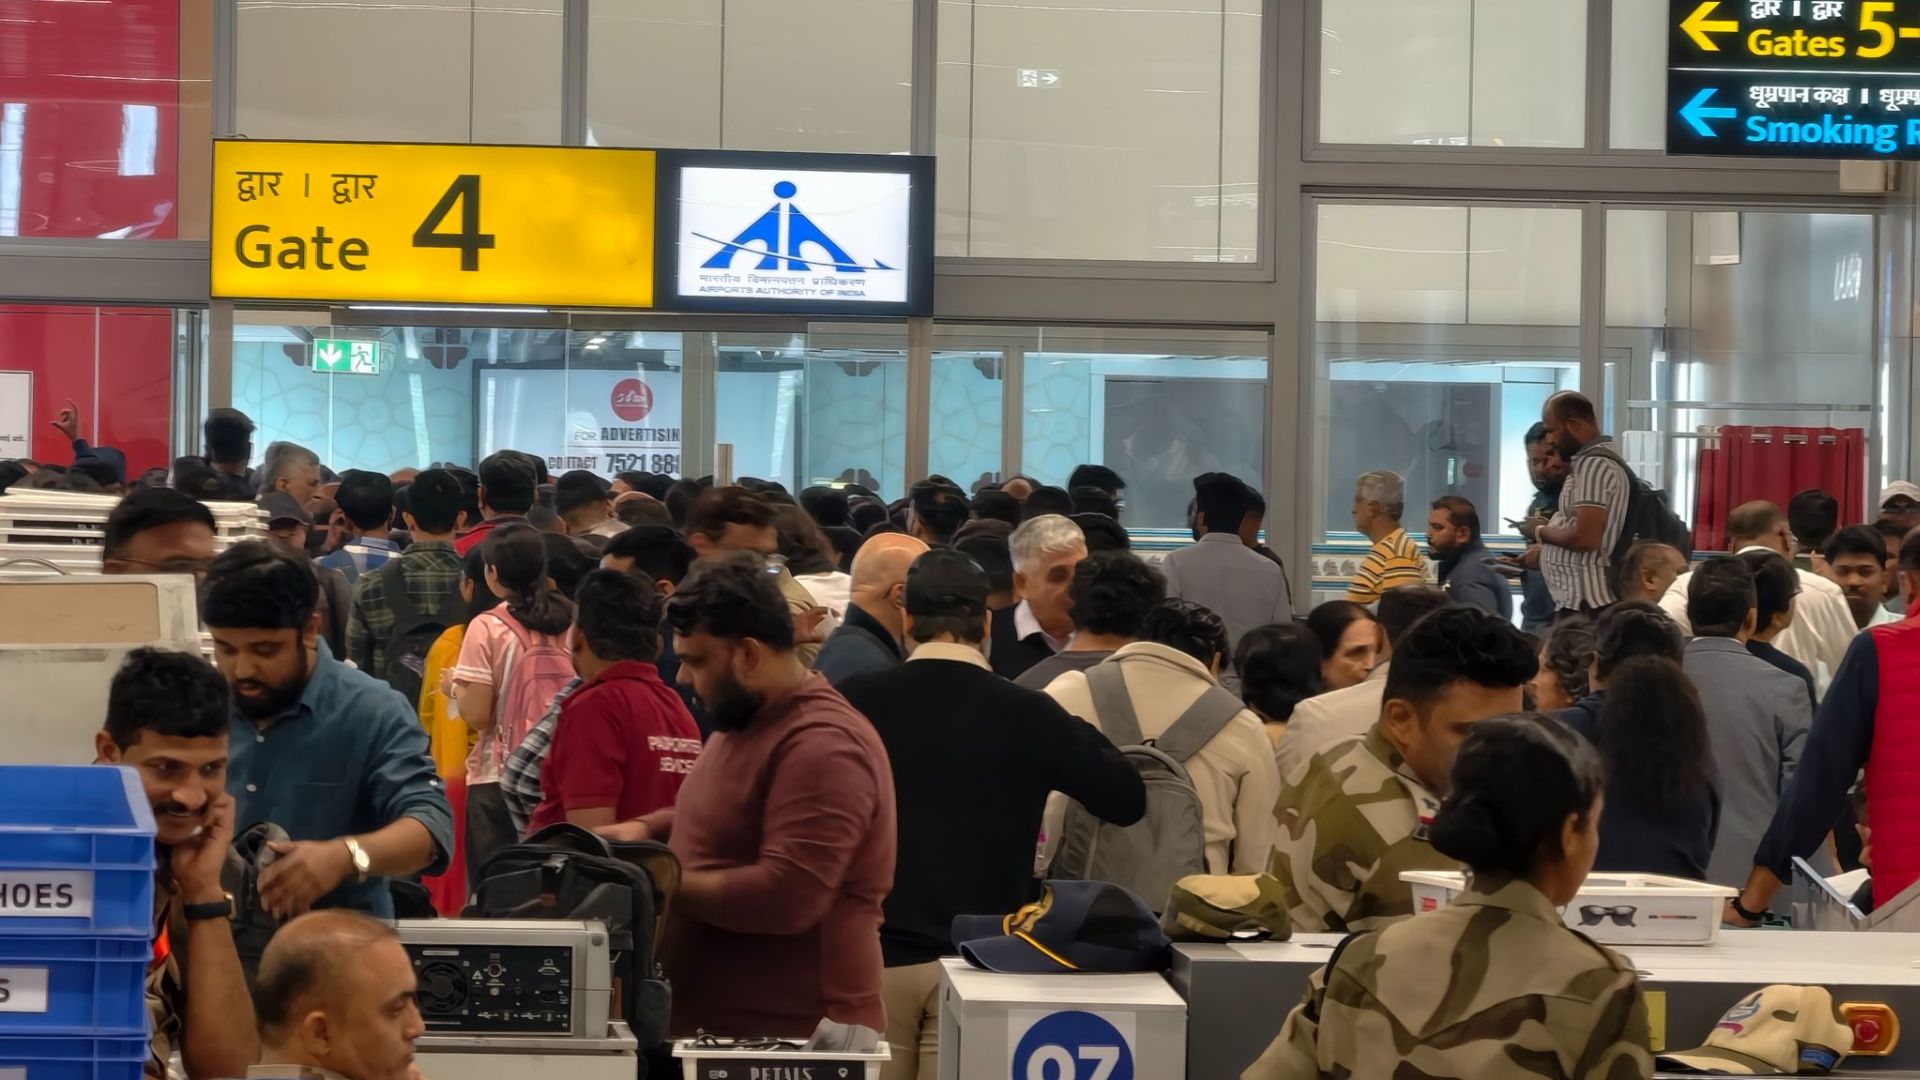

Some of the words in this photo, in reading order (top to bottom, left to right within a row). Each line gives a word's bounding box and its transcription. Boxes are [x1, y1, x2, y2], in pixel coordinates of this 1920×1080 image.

[1811, 0, 1845, 21] द्वार
[1747, 28, 1846, 57] Gates
[1749, 85, 1810, 108] धूम्रपान
[1812, 87, 1850, 105] कक्ष
[1746, 114, 1898, 153] Smoking
[235, 171, 283, 202] द्वार
[331, 173, 378, 205] द्वार
[234, 223, 370, 271] Gate
[411, 173, 496, 272] 4
[698, 285, 753, 294] AIRPORTS
[755, 287, 816, 296] AUTHORITY
[573, 431, 598, 441] FOR
[1026, 1045, 1120, 1080] 07
